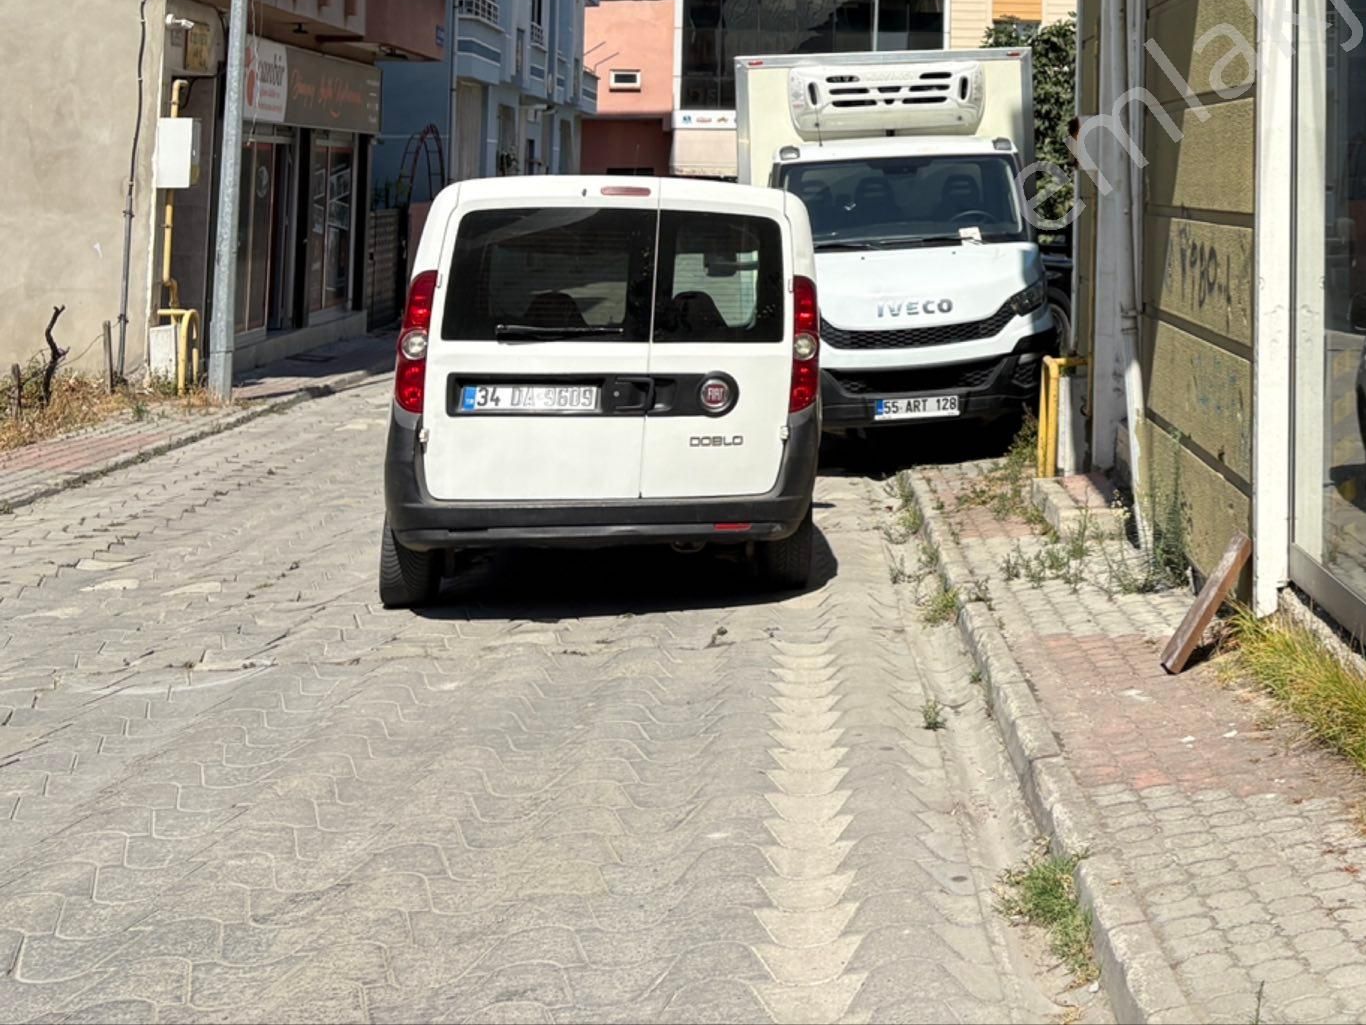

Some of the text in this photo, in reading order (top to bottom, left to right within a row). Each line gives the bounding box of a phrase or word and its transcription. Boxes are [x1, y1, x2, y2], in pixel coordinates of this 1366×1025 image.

[877, 298, 953, 318] IVECO
[477, 386, 501, 407] 34
[883, 396, 957, 414] 55 ART 128
[689, 435, 744, 448] DOBLO
